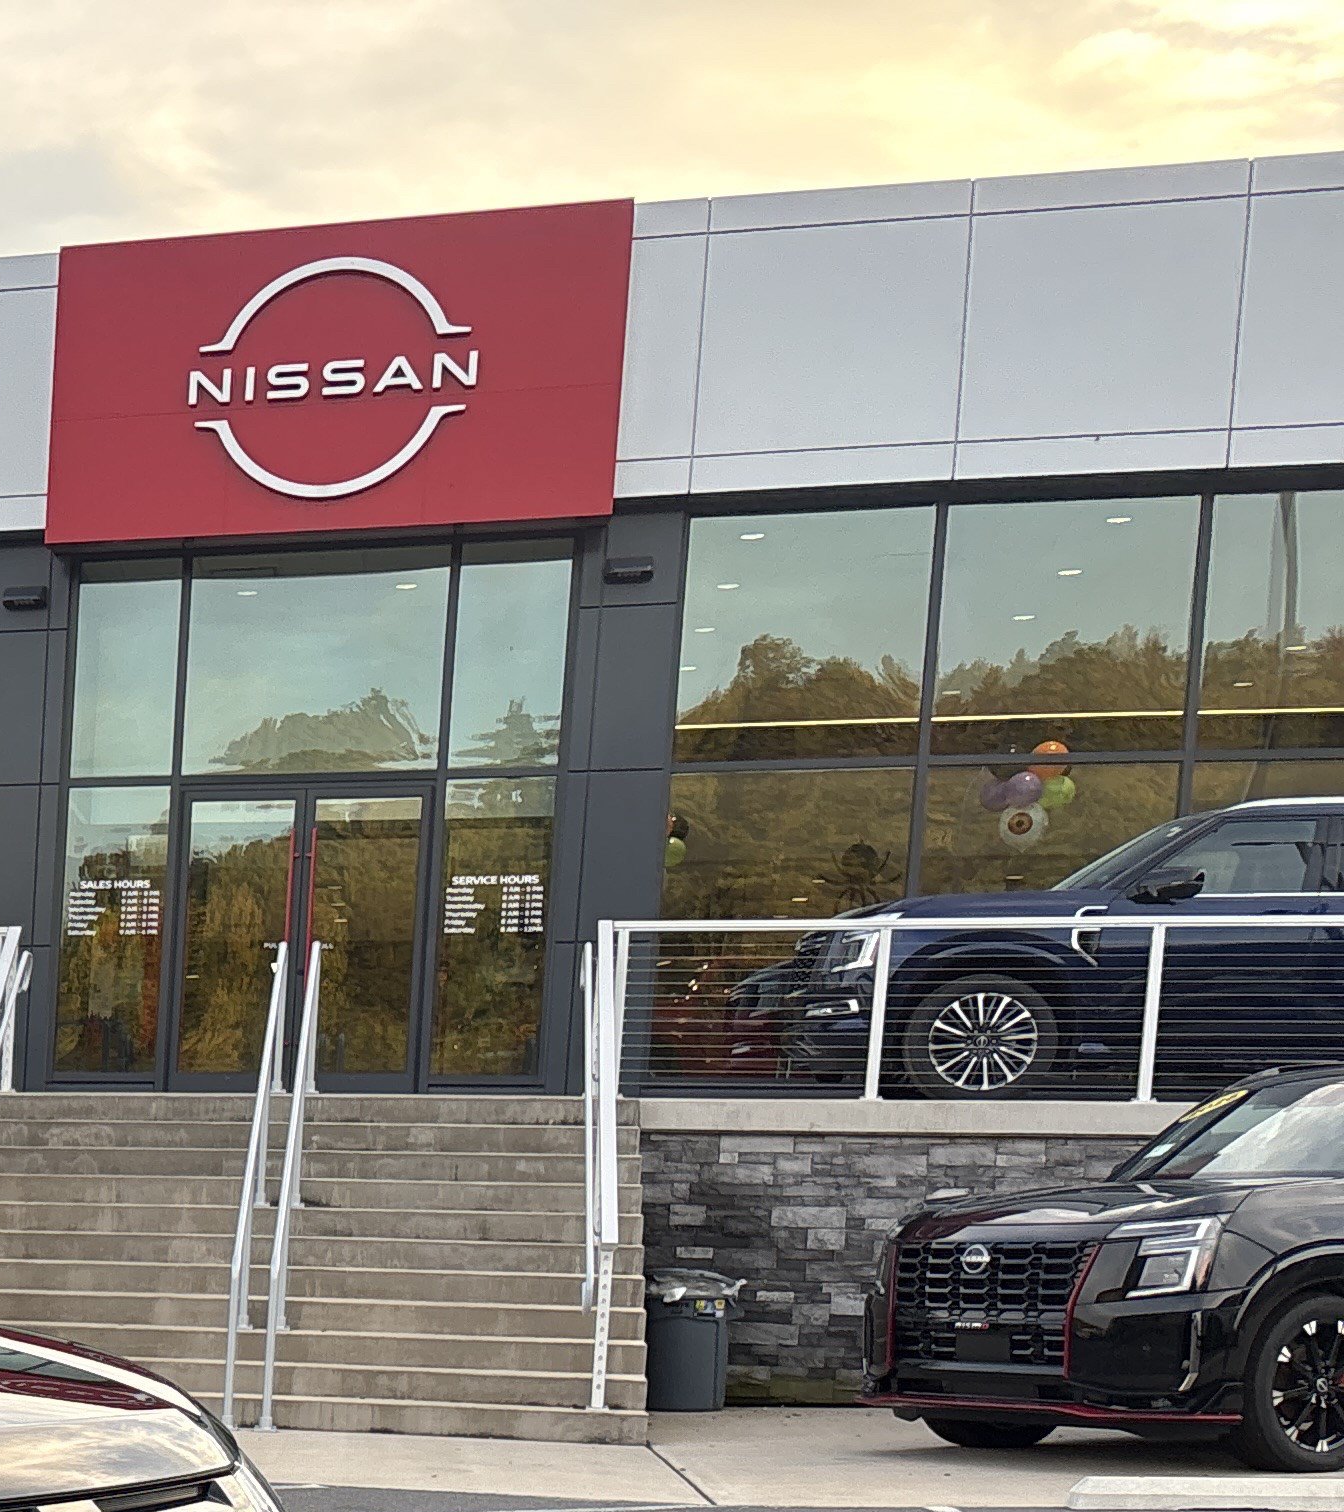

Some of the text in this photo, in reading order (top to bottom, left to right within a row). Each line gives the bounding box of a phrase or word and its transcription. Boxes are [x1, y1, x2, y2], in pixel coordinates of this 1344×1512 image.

[188, 350, 479, 406] NISSAN
[80, 879, 151, 889] SALES HOURS
[452, 874, 540, 885] SERVICE HOURS
